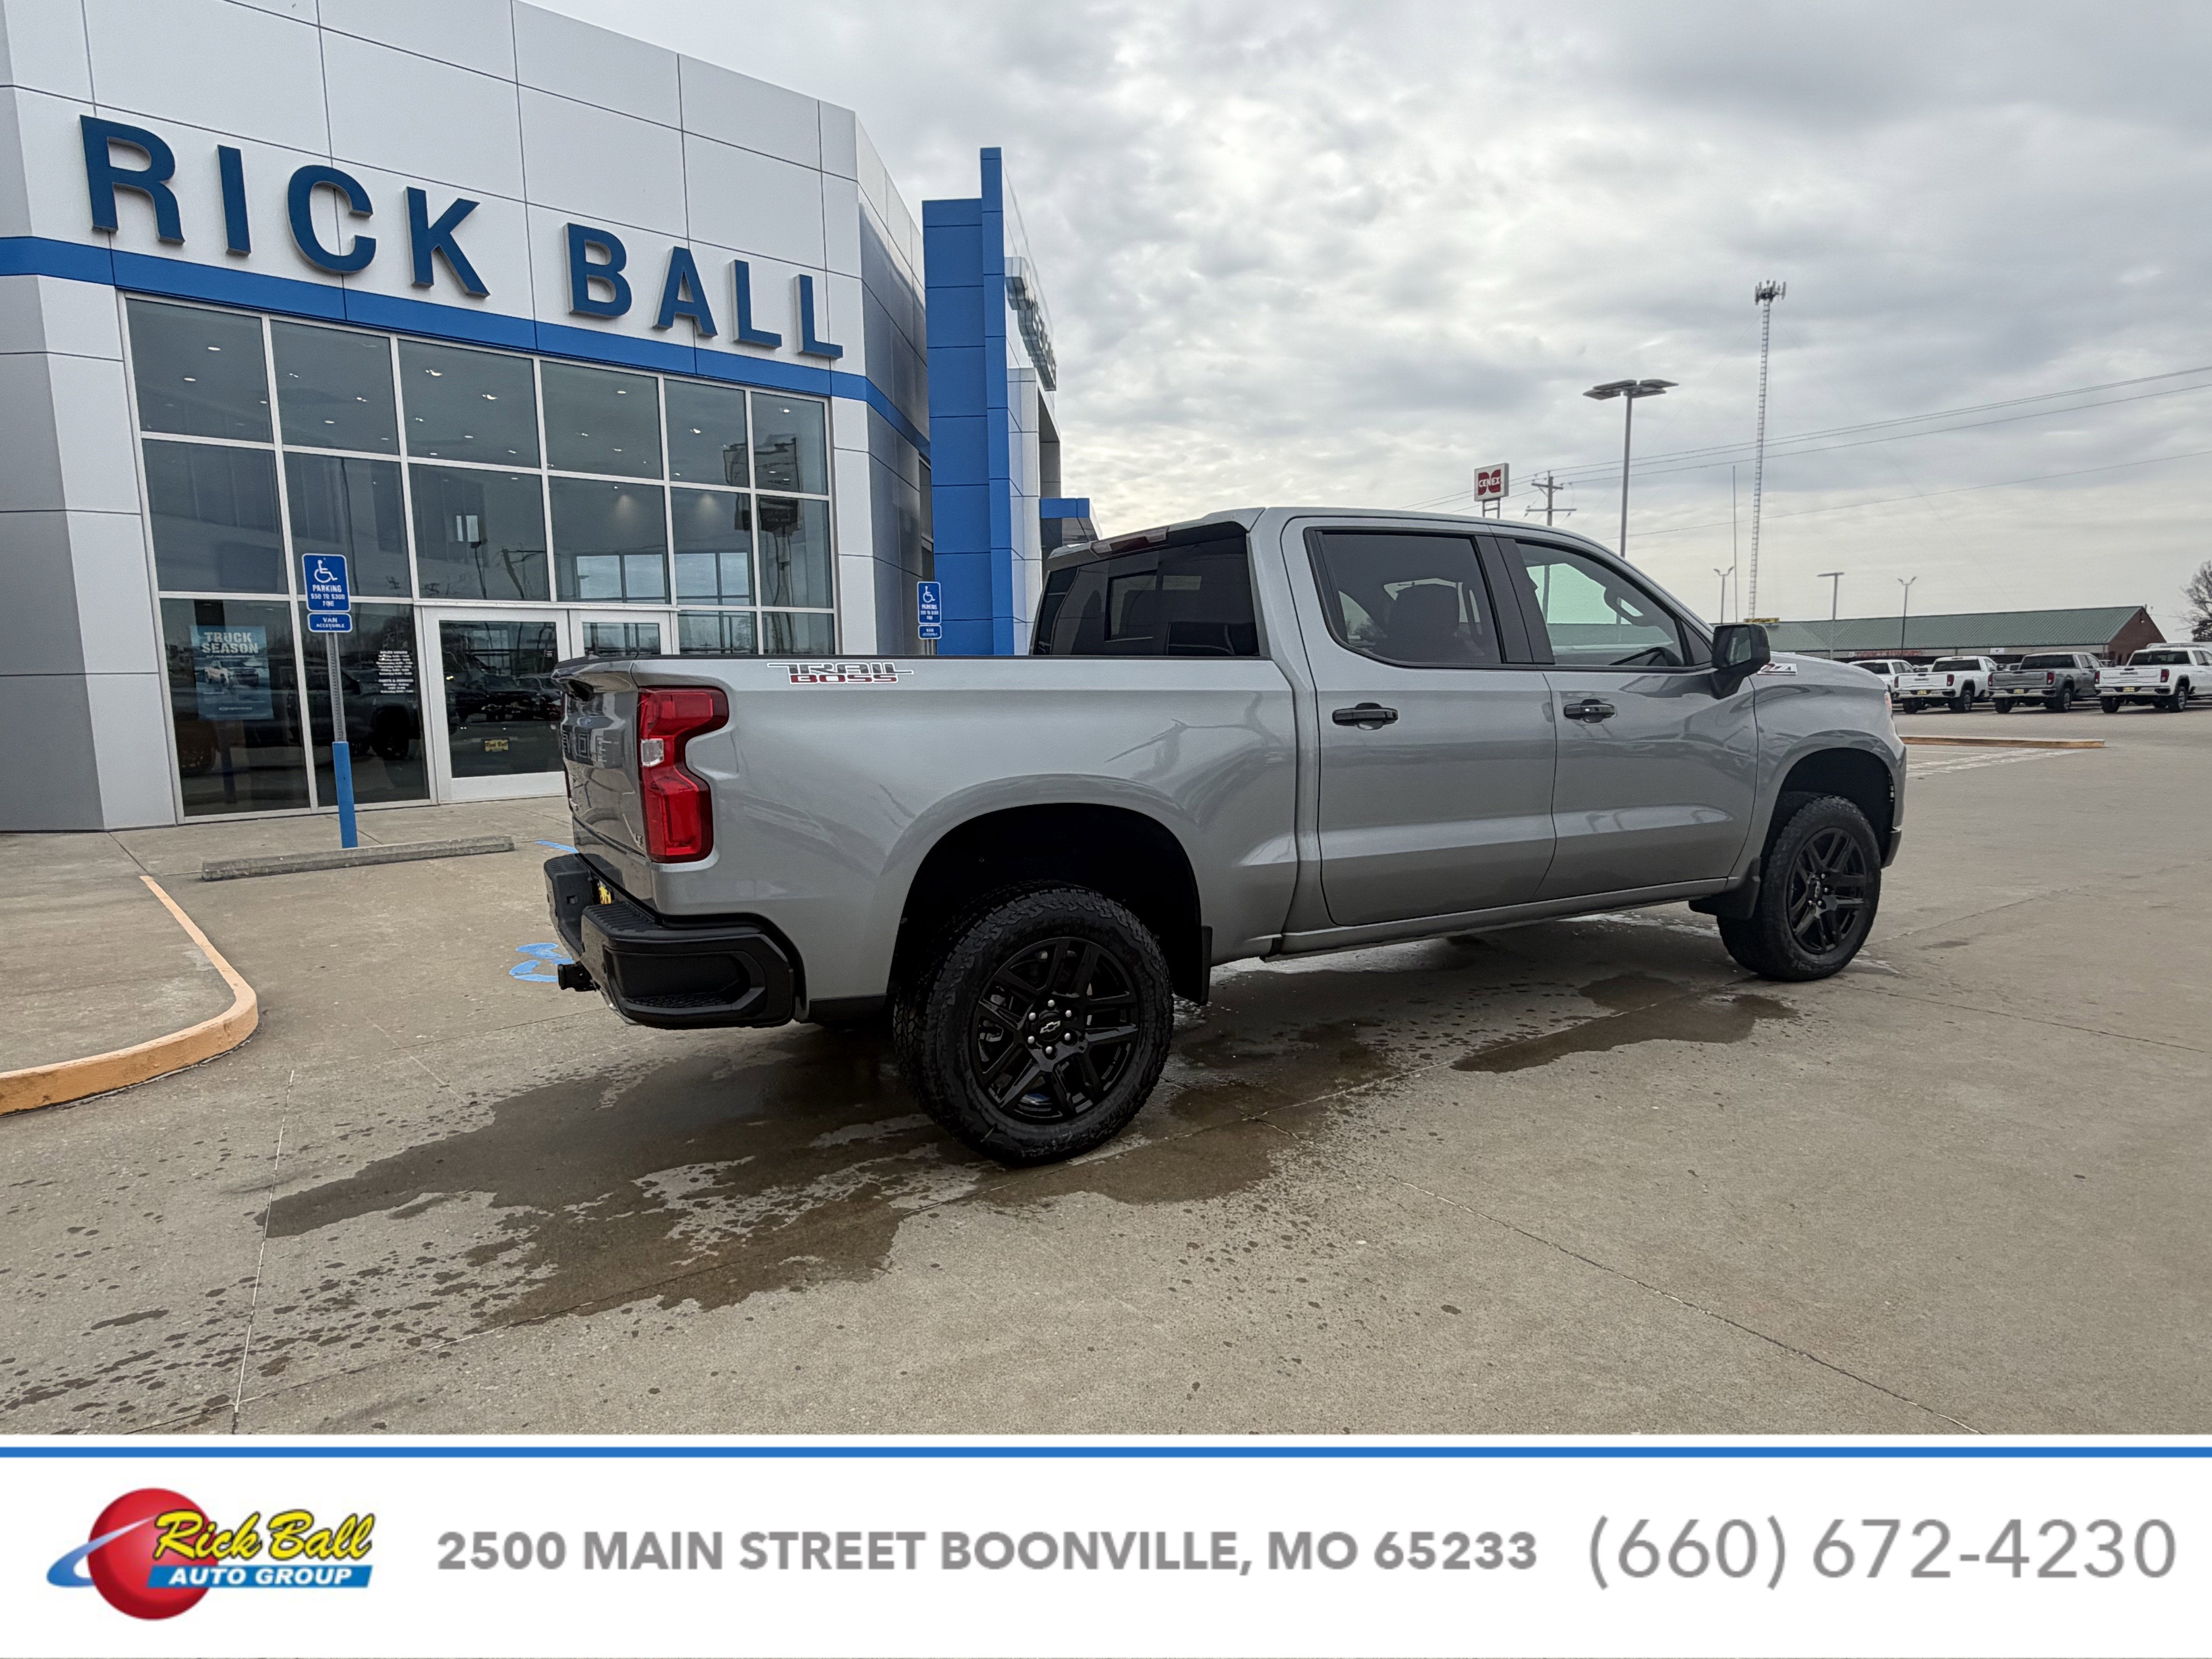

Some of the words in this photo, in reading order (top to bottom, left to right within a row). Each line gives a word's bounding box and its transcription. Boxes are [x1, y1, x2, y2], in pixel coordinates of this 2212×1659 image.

[79, 114, 490, 298] RICK
[563, 222, 843, 359] BALL
[1479, 477, 1501, 487] CENEX
[312, 584, 342, 592] PARKING
[204, 632, 252, 643] TRUCK
[201, 642, 259, 654] SEASON
[767, 662, 914, 675] TRAIL
[789, 673, 898, 684] BOSS
